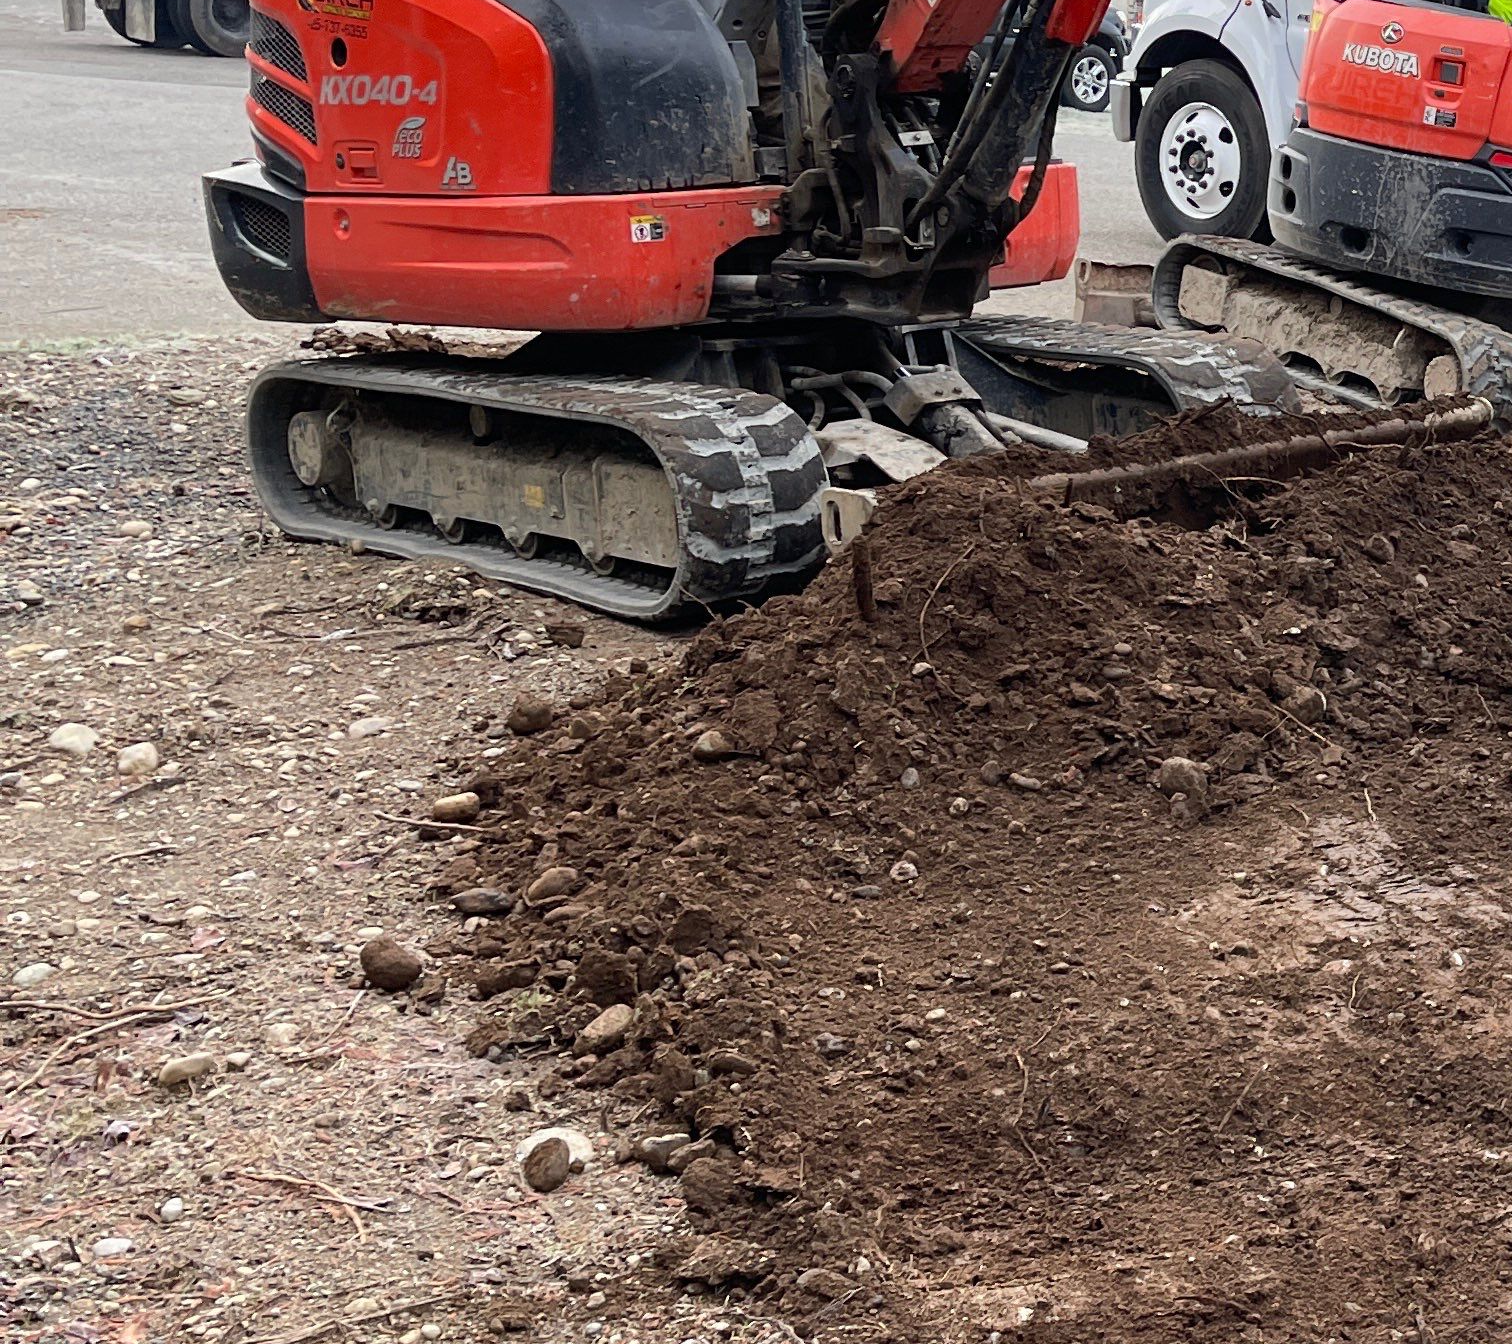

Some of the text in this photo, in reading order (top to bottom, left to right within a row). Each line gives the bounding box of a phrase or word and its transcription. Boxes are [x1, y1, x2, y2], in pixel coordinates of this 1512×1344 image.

[1342, 44, 1420, 78] KUBOTA
[319, 75, 438, 105] KX040-4
[392, 144, 422, 159] PLUS
